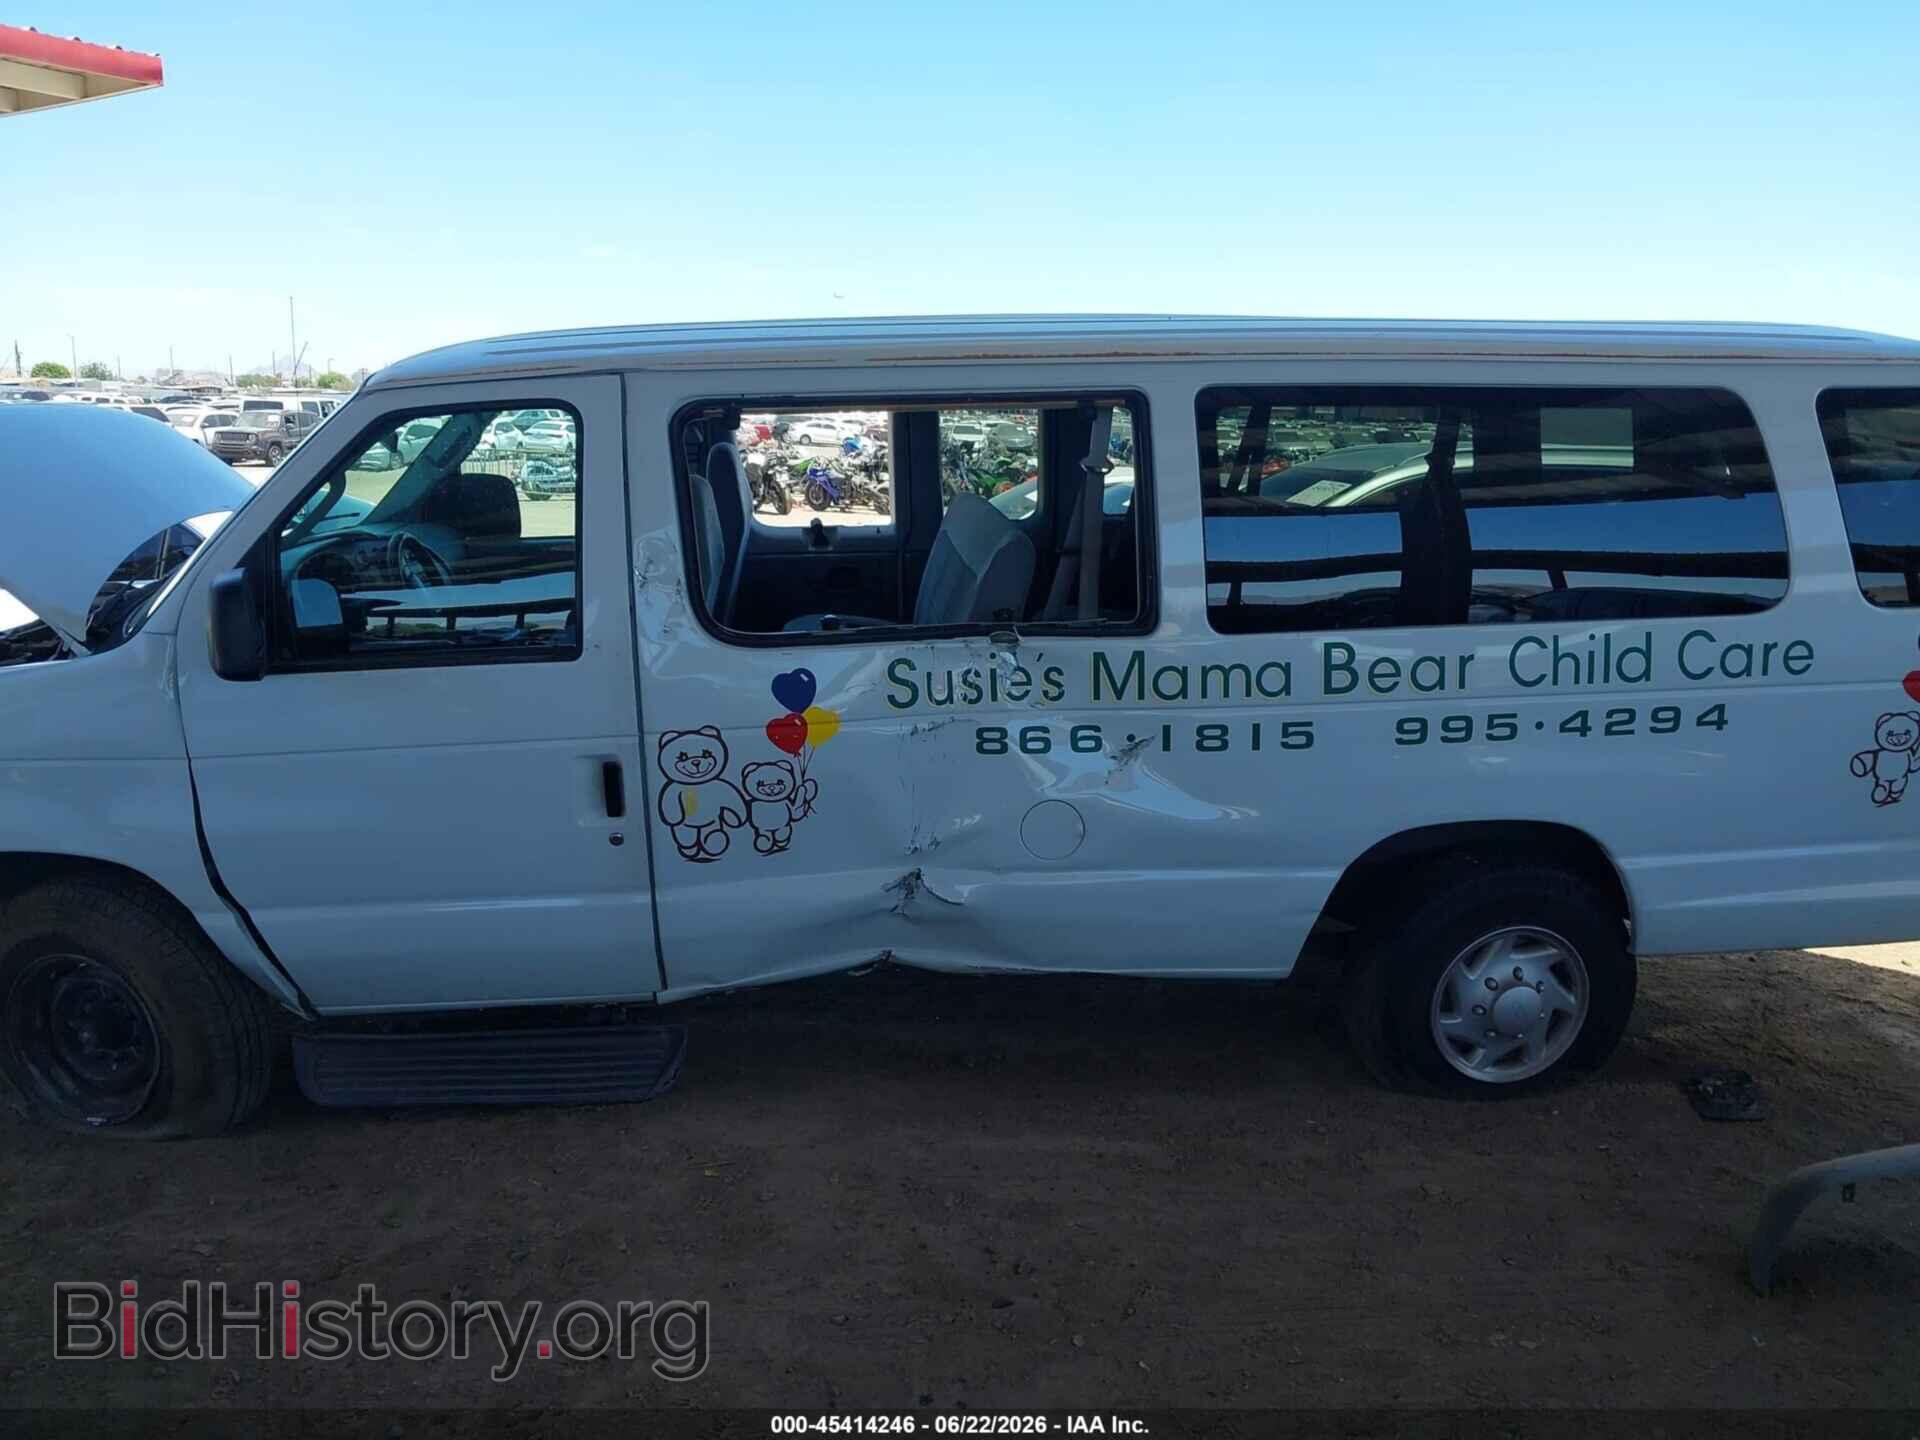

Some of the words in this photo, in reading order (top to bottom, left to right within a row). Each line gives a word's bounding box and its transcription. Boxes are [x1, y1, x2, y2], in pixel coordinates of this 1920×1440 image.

[887, 652, 1066, 709] Susie's
[1092, 650, 1292, 701] Mama
[1323, 641, 1475, 696] Bear
[1509, 631, 1653, 688] Child
[1677, 628, 1815, 681] Care
